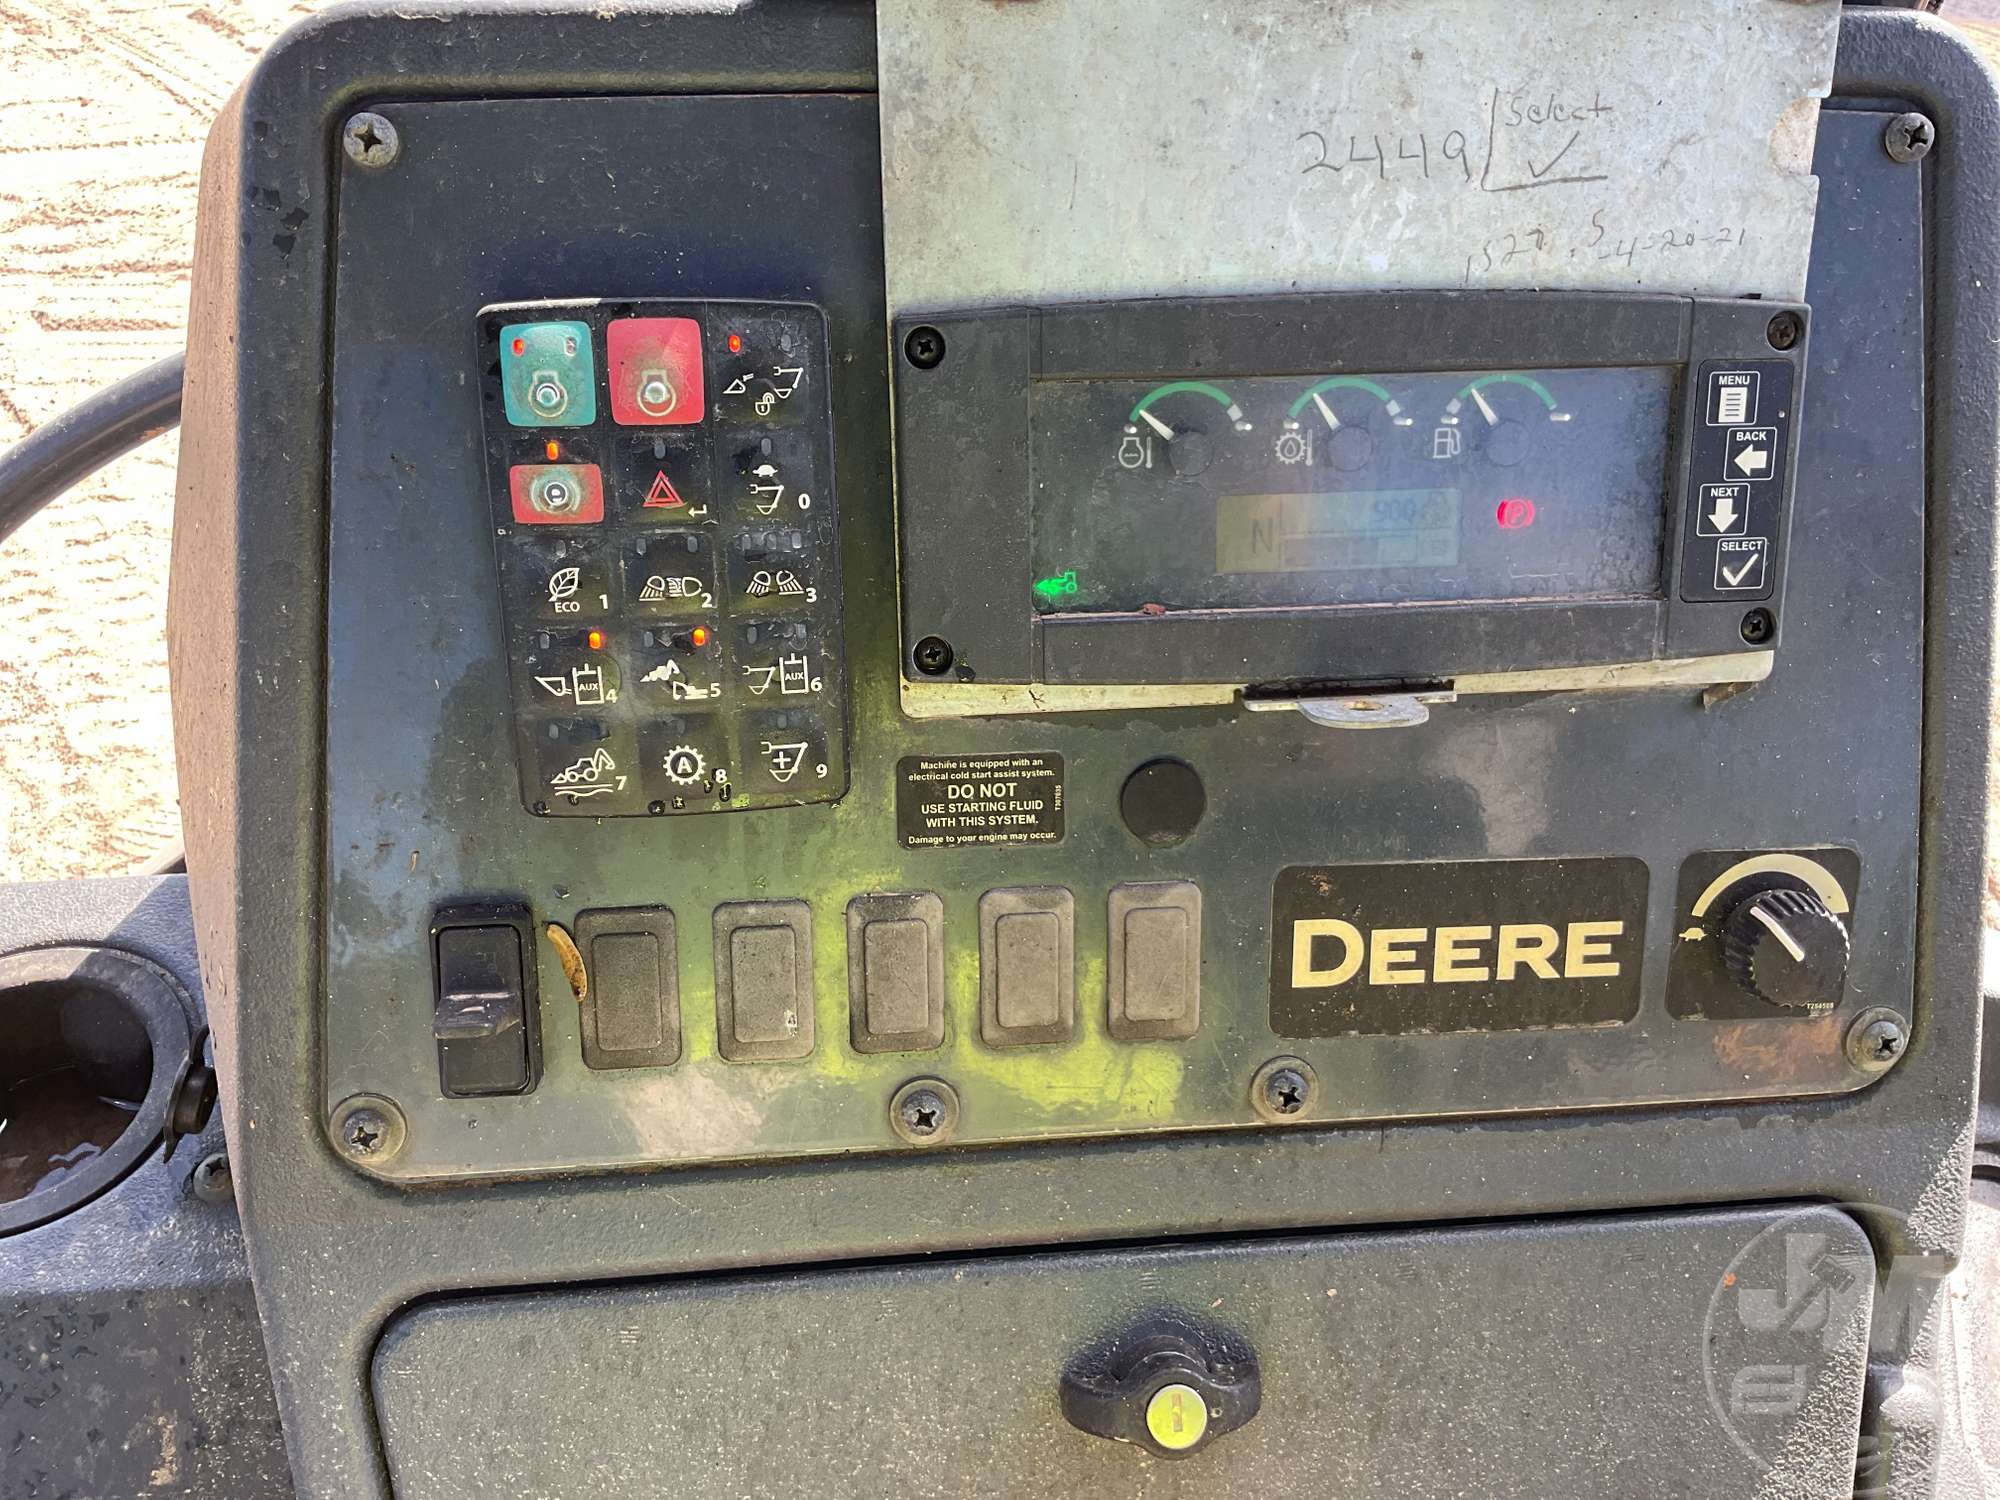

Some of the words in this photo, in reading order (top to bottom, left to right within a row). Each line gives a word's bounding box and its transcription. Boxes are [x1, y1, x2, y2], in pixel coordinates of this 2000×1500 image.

[1506, 92, 1612, 128] Select
[1718, 375, 1750, 386] MENU
[1735, 431, 1767, 442] BACK
[1710, 487, 1740, 498] NEXT
[1251, 519, 1274, 554] N
[1720, 541, 1763, 553] SELECT
[600, 594, 609, 609] 1
[700, 593, 713, 608] 2
[806, 588, 817, 602] 3
[554, 601, 581, 613] ECO
[784, 671, 805, 681] AUX
[578, 682, 598, 692] AUX
[709, 683, 721, 698] 5
[810, 678, 822, 692] 6
[605, 689, 617, 703] 4
[815, 763, 828, 779] 9
[920, 761, 957, 770] Machine
[959, 760, 967, 769] is
[969, 760, 1010, 770] equipped
[1012, 758, 1030, 766] with
[714, 769, 728, 784] 8
[908, 772, 948, 781] electrical
[950, 771, 969, 780] cold
[972, 770, 992, 778] start
[993, 769, 1019, 778] assist
[1021, 769, 1056, 777] system.
[614, 775, 627, 791] 7
[948, 784, 974, 799] DO
[980, 782, 1018, 798] NOT
[921, 804, 945, 814] USE
[949, 801, 1006, 814] STARTING
[1009, 800, 1044, 811] FLUID
[926, 817, 956, 828] WITH
[959, 816, 986, 827] THIS
[989, 814, 1039, 826] SYSTEM.
[908, 835, 944, 845] Damage
[957, 836, 977, 844] your
[978, 833, 1008, 844] engine
[1010, 833, 1028, 842] may
[1030, 831, 1057, 840] occur.
[1291, 918, 1624, 989] DEERE
